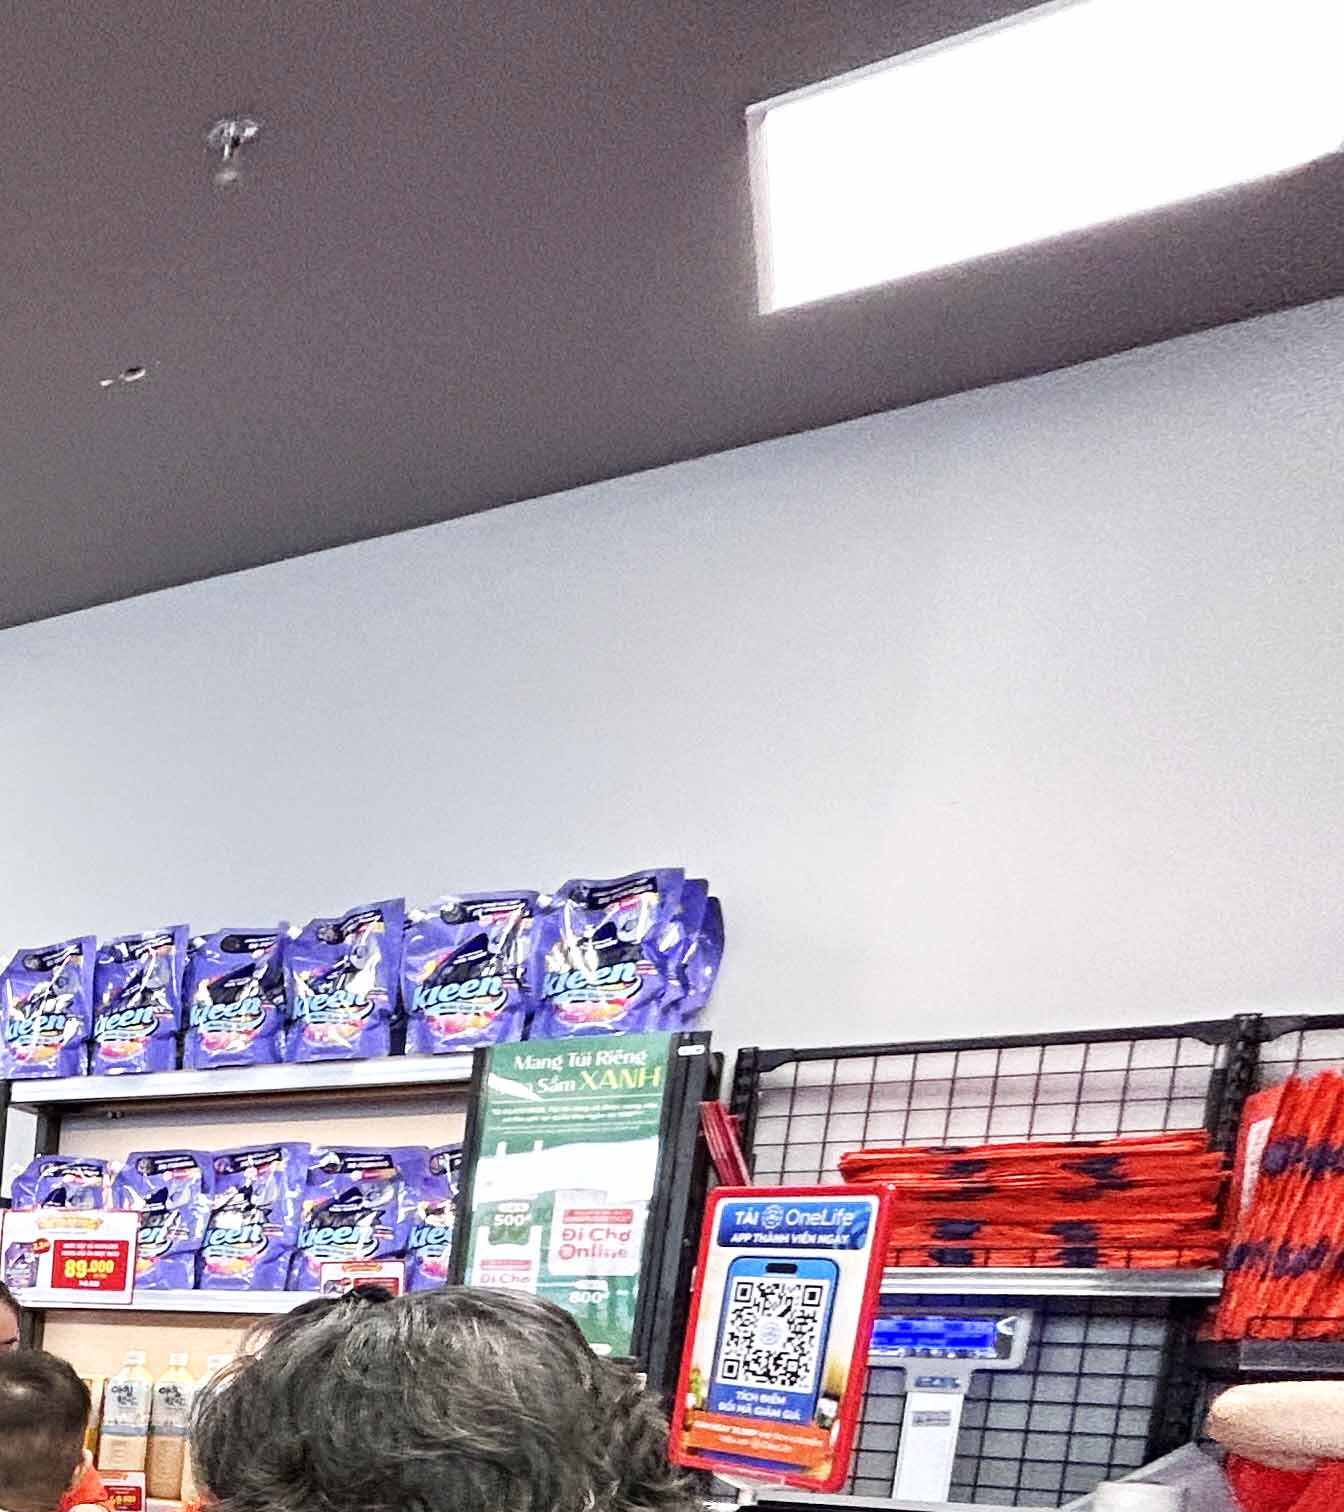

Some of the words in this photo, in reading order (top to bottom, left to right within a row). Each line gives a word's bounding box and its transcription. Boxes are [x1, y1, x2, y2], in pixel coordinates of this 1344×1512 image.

[514, 1054, 564, 1071] Mang
[538, 1077, 576, 1093] Sắm
[578, 1066, 661, 1091] XANH
[785, 1208, 855, 1227] OneLife
